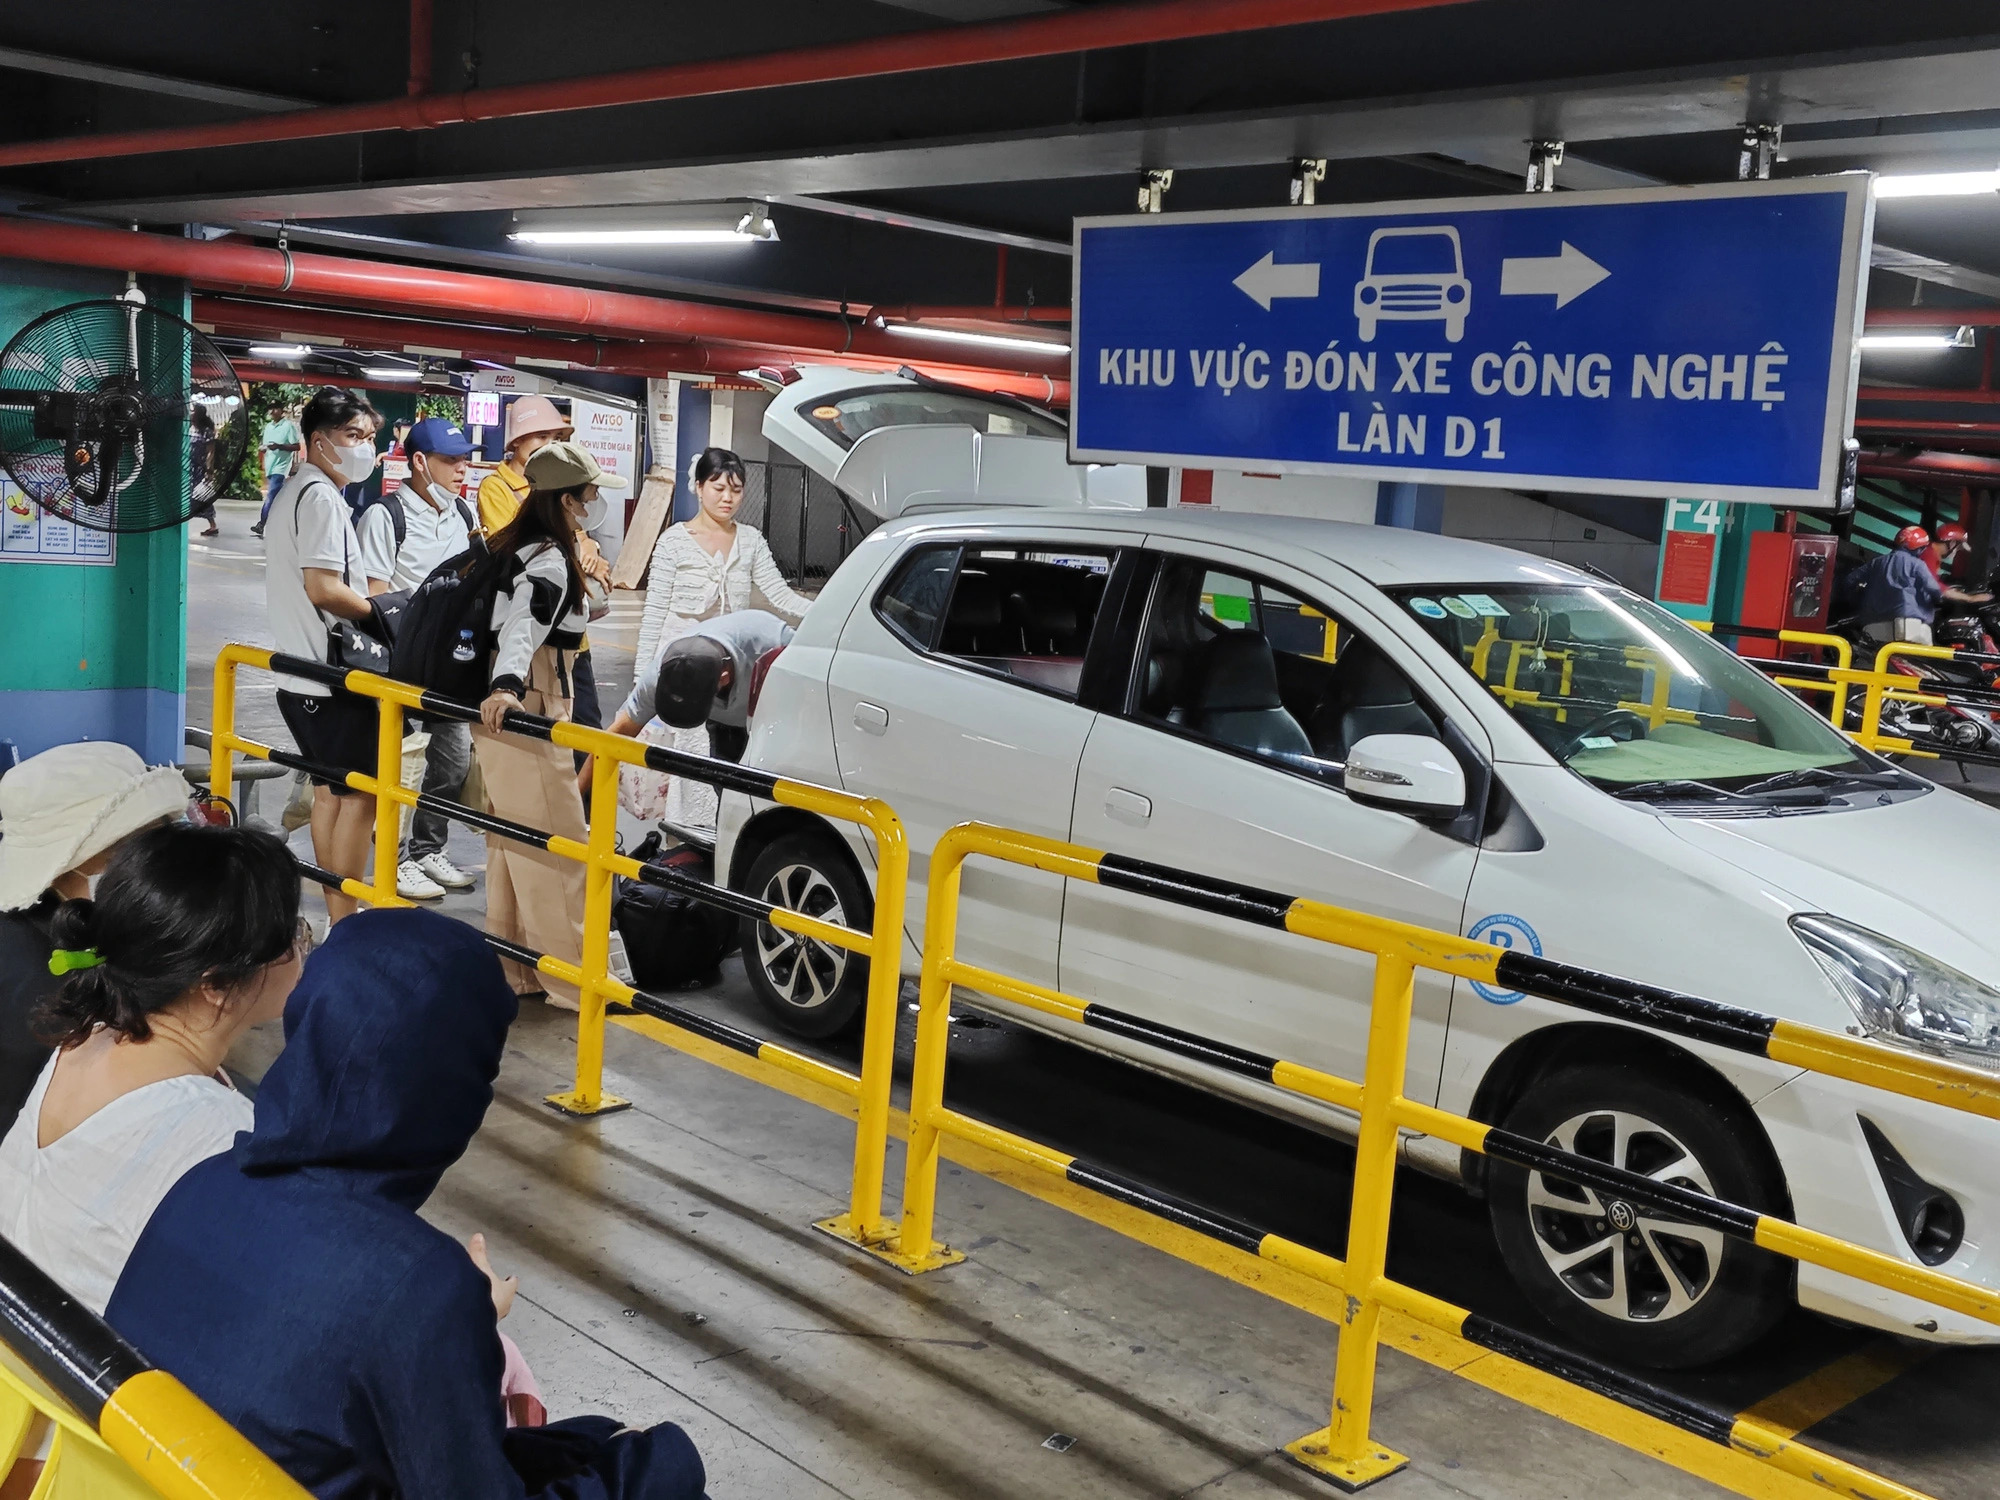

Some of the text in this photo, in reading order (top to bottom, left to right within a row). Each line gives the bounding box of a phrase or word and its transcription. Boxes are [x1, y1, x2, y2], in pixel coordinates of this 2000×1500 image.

[1099, 339, 1789, 411] KHU VỰC ĐÓN XE CÔNG NGHỆ
[1336, 401, 1506, 460] LÀN D1
